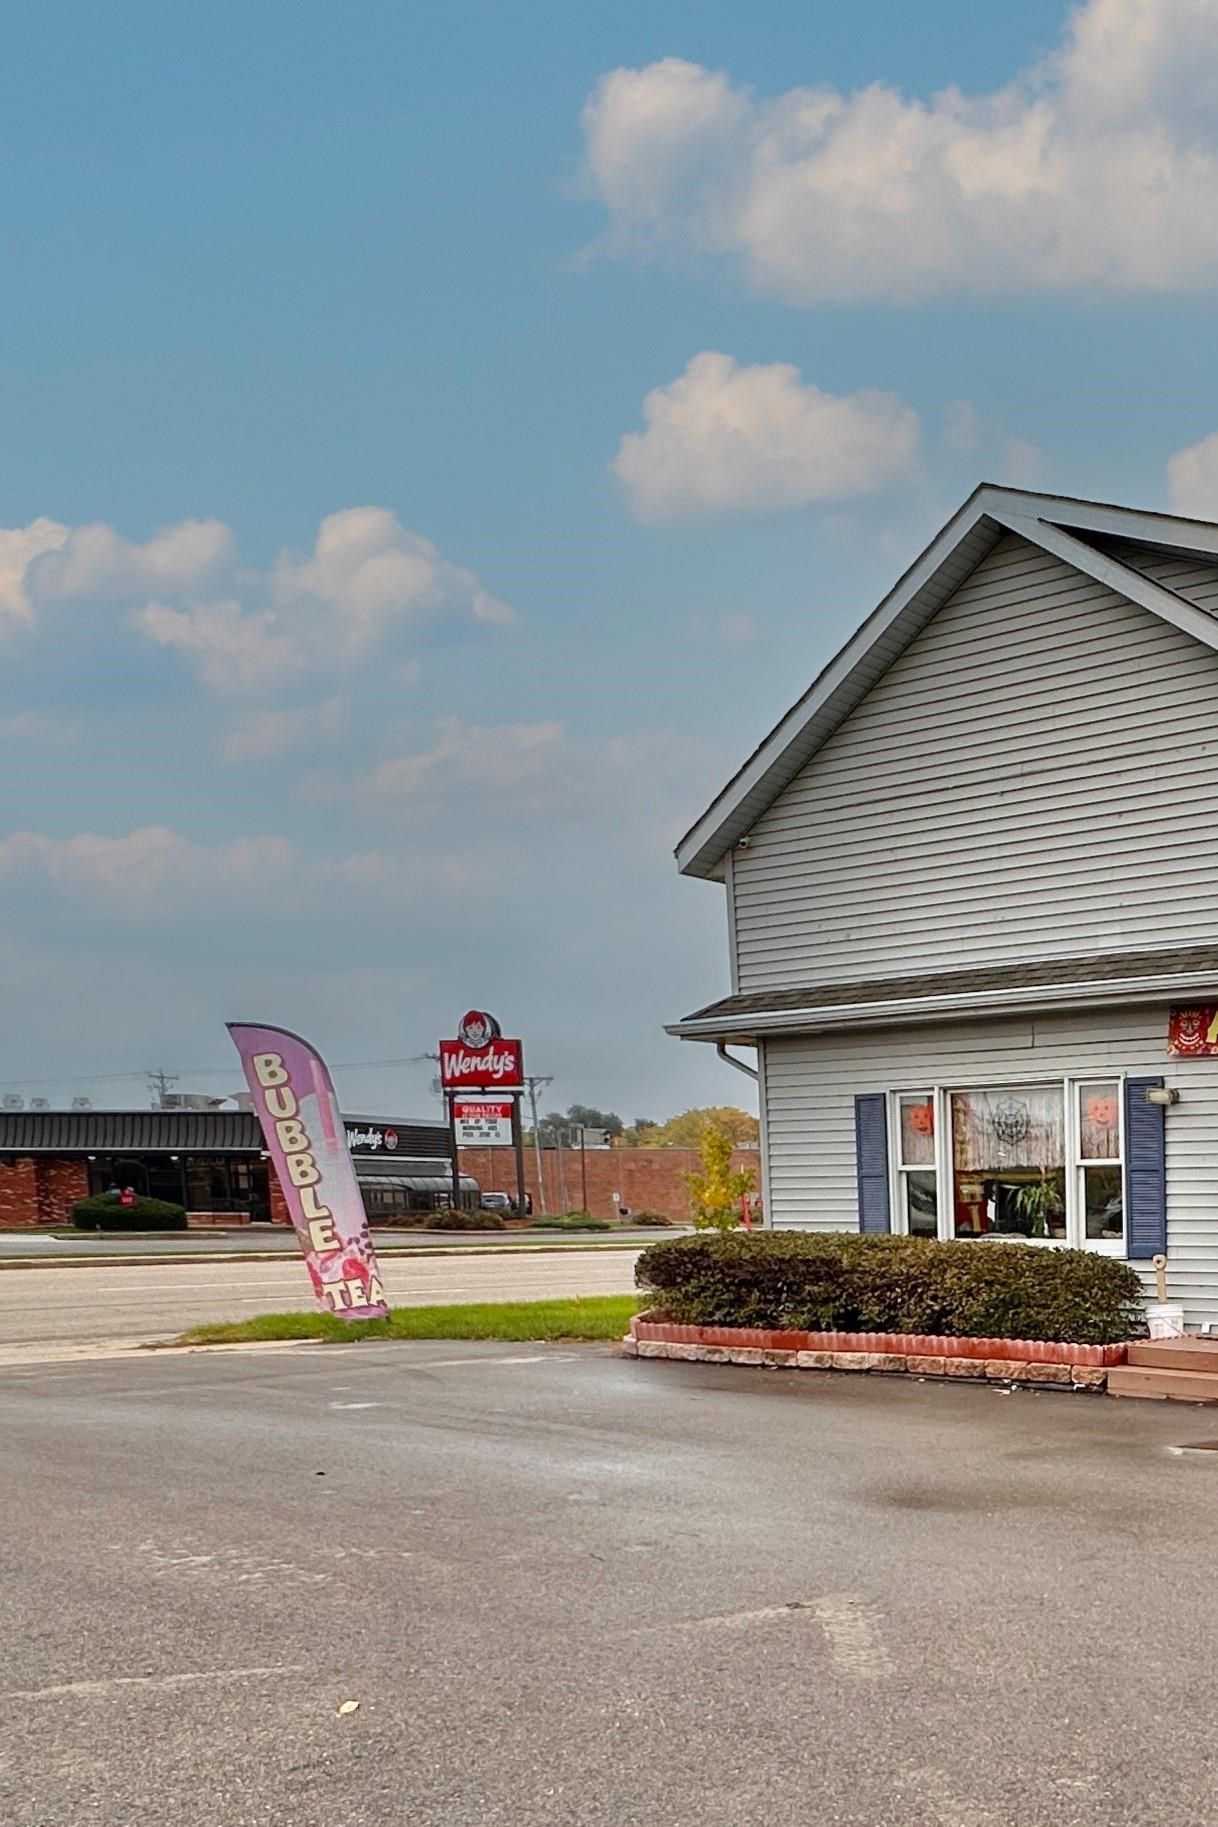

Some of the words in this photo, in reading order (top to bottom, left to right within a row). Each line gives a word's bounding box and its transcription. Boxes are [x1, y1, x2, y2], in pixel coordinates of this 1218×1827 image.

[443, 1045, 515, 1080] Wendy's
[461, 1104, 503, 1114] QUALITY
[252, 1052, 341, 1252] BUBBLE
[346, 1127, 383, 1150] Wendy's
[323, 1274, 385, 1311] TEA
